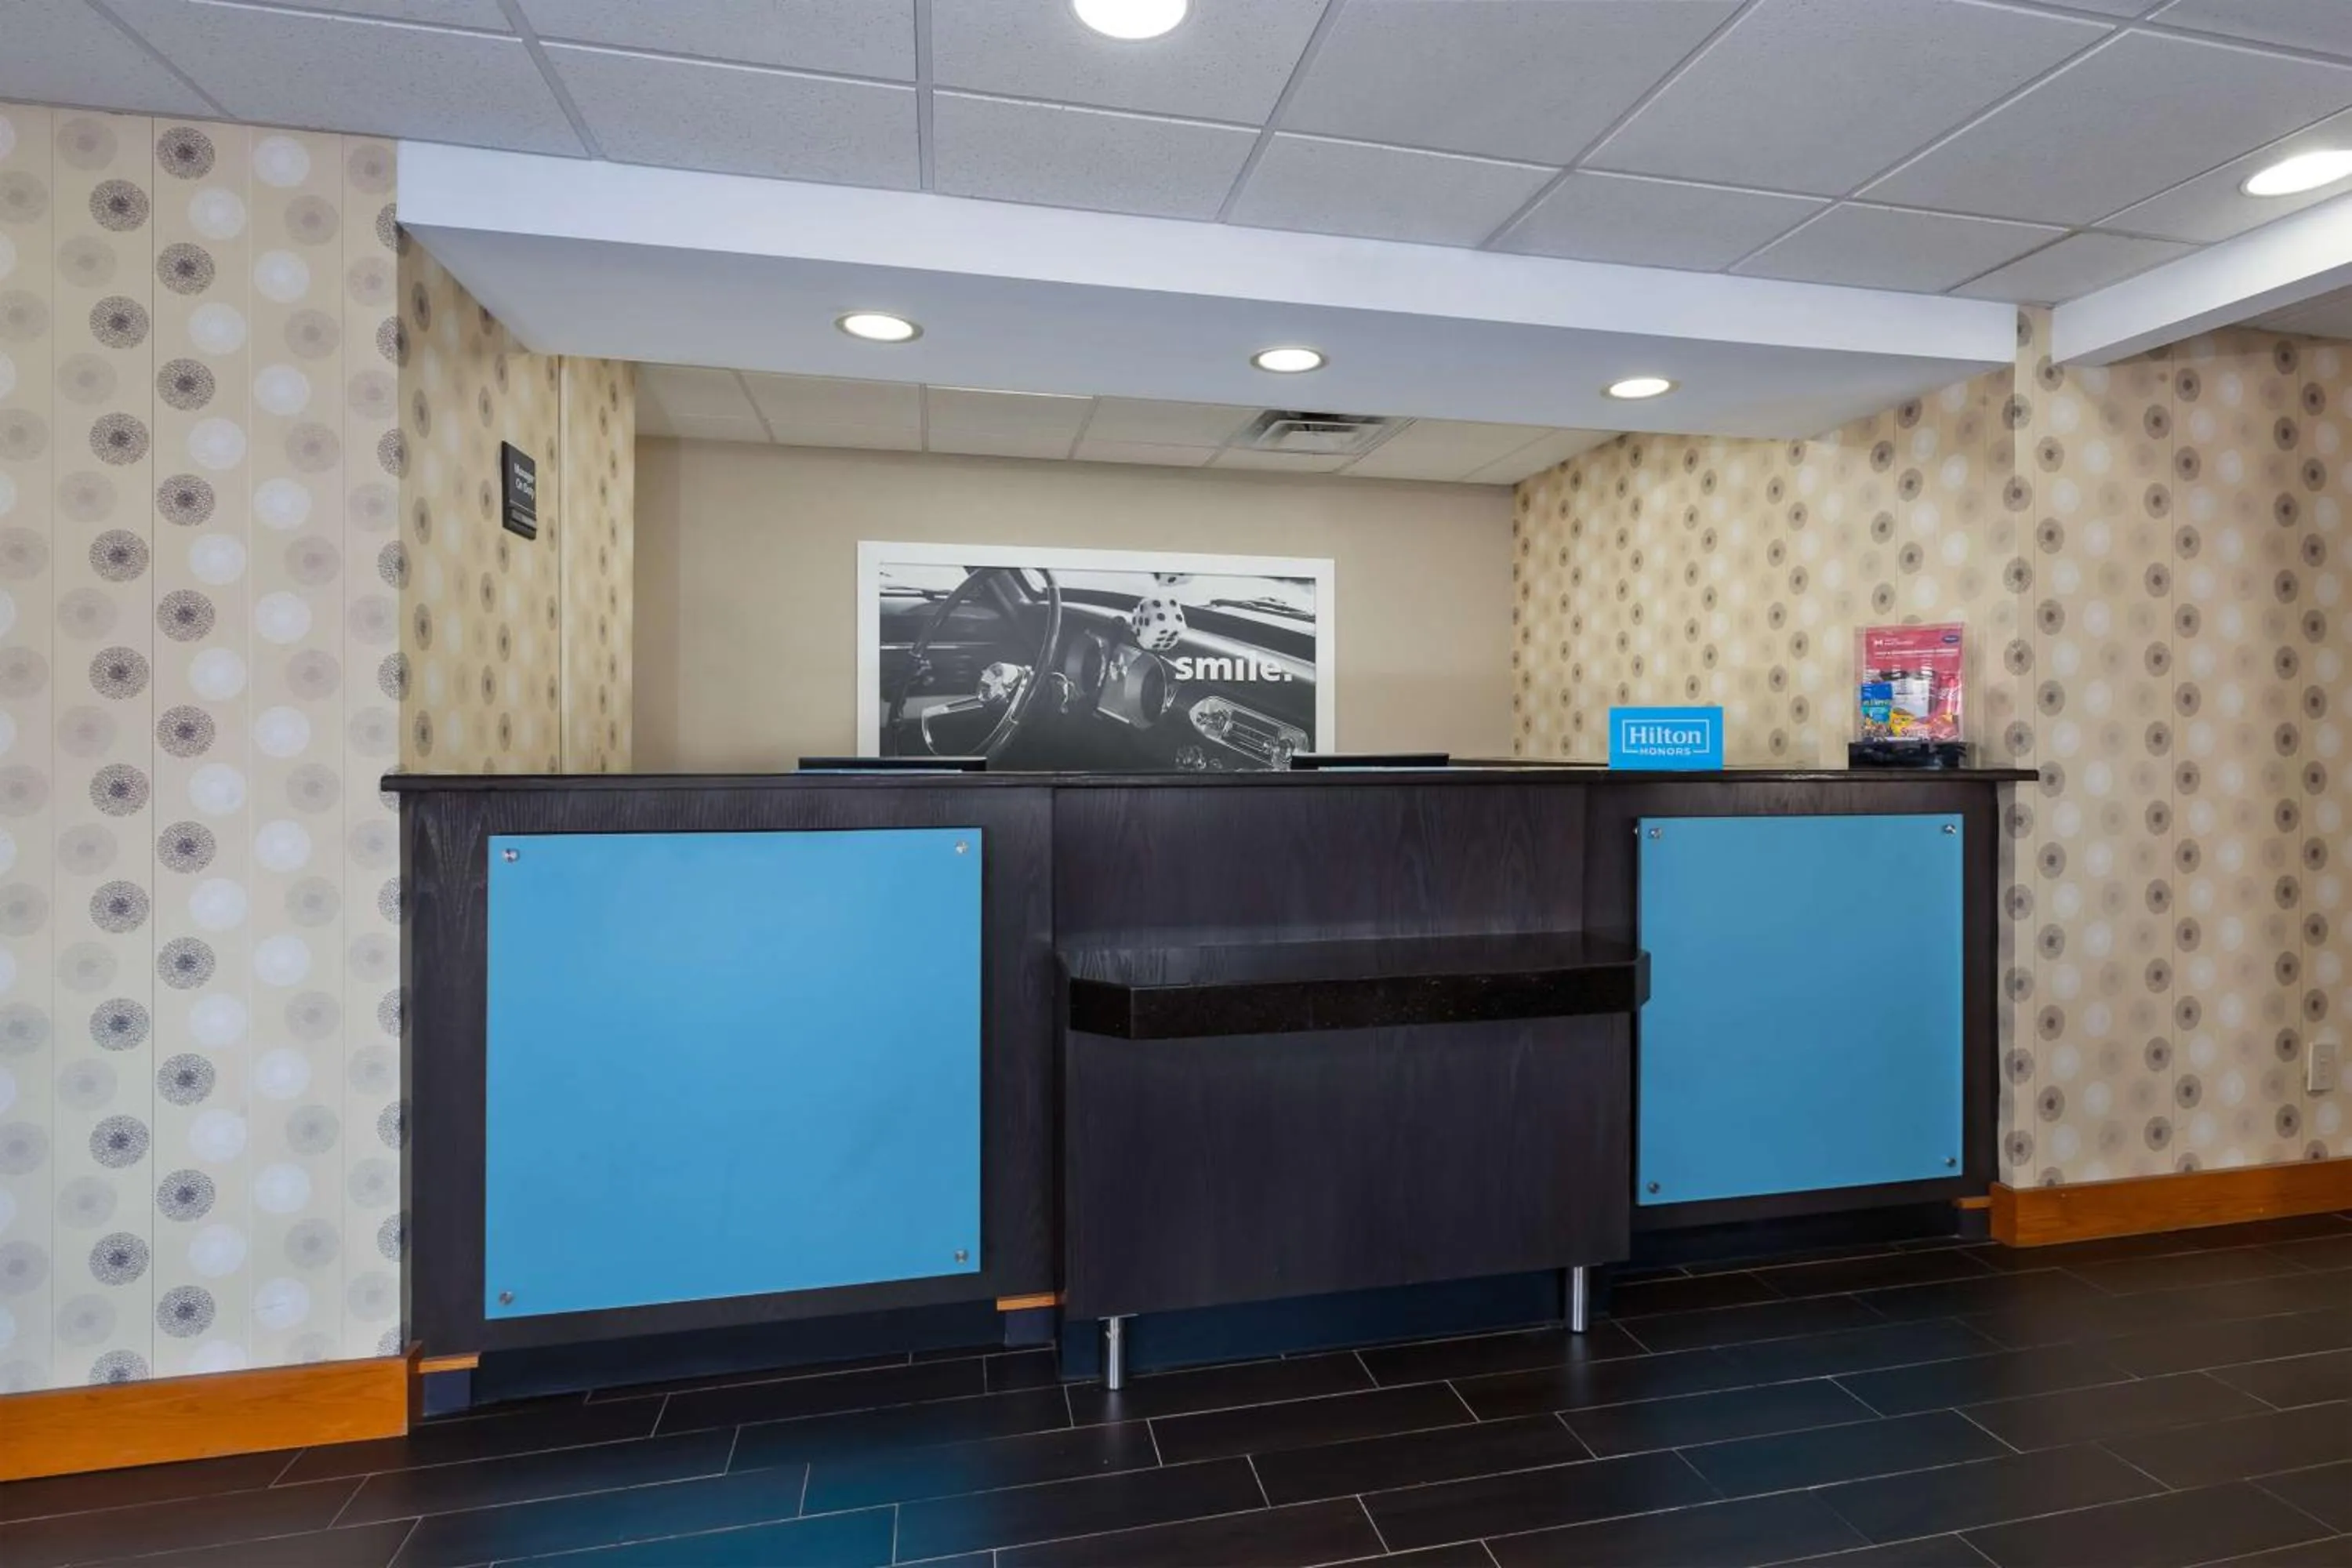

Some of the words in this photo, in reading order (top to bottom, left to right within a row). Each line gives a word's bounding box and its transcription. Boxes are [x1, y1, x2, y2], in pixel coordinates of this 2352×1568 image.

[1175, 650, 1293, 682] smile.
[1629, 726, 1701, 745] Hilton
[1639, 747, 1691, 756] HONORS
